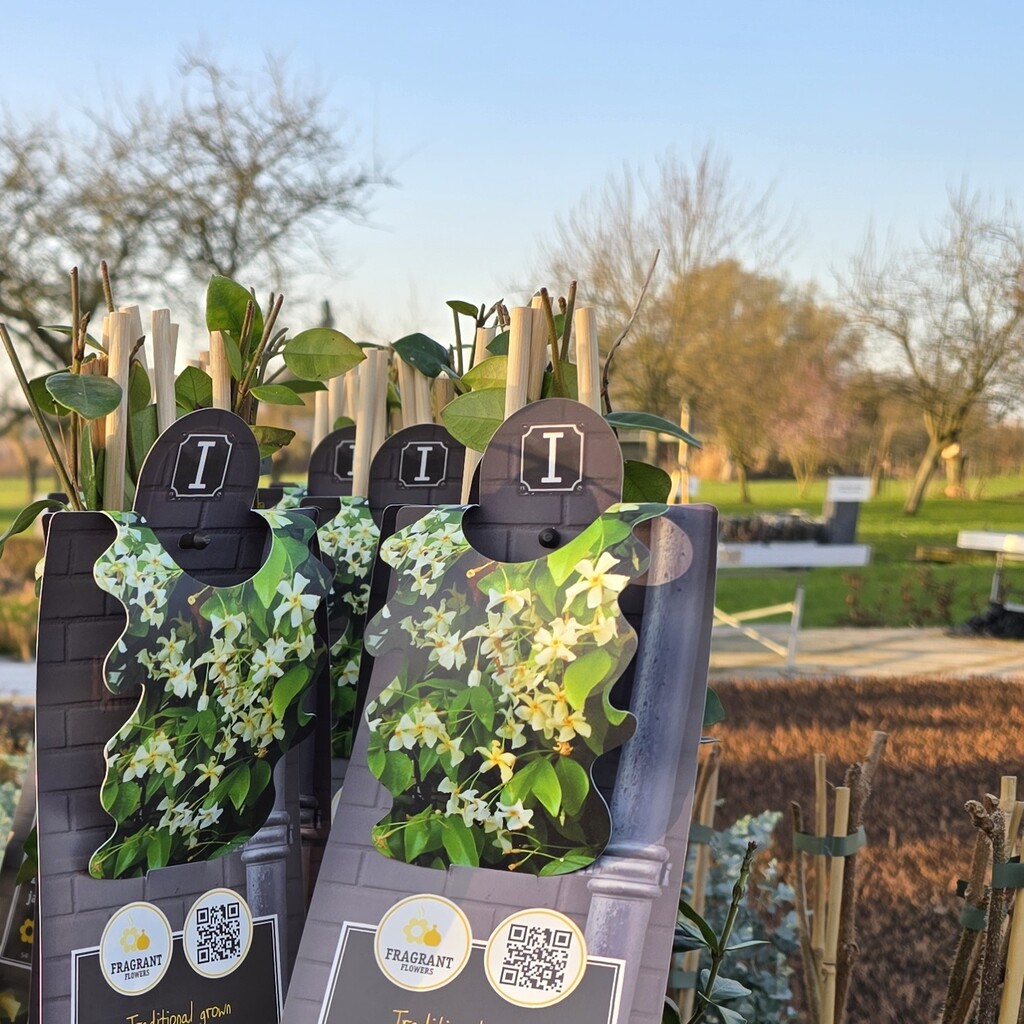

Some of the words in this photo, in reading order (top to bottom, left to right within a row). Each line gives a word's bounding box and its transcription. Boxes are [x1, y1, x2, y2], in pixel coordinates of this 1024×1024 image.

[188, 441, 216, 490] I
[415, 446, 433, 482] I
[541, 432, 564, 483] I
[110, 954, 163, 975] FRAGRANT
[384, 947, 454, 971] FRAGRANT
[400, 964, 434, 976] FLOWERS
[124, 969, 150, 981] FLOWERS
